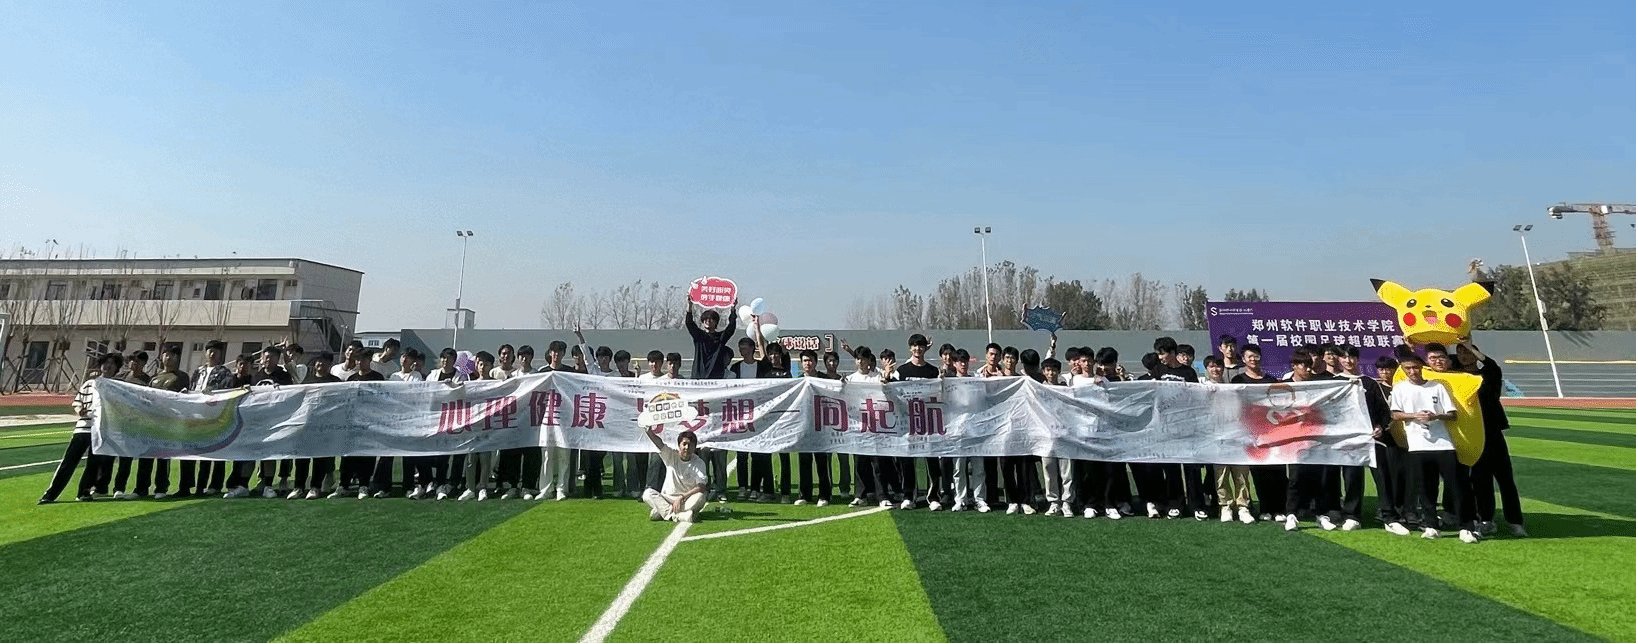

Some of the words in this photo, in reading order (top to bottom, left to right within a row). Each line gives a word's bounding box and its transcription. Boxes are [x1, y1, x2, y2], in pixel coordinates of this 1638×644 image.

[1251, 319, 1396, 332] 郑州软件职业技术学院
[1246, 334, 1406, 348] 第一届校园足球超级联赛
